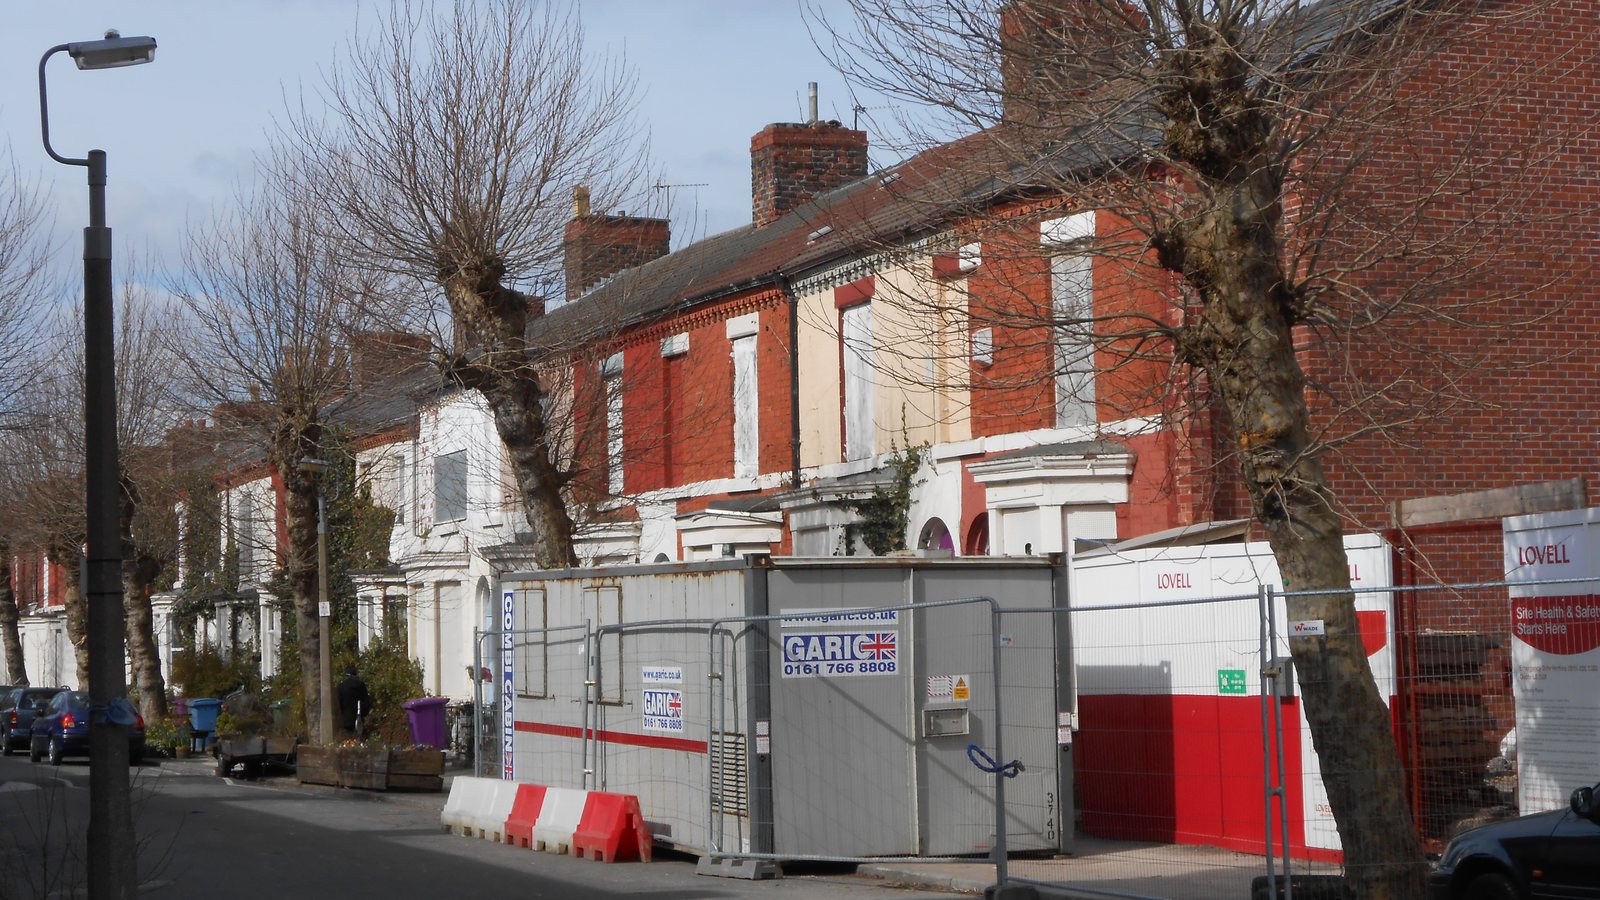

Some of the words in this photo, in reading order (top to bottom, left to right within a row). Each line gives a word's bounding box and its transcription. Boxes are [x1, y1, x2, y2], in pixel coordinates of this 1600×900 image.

[1518, 544, 1571, 566] LOVELL
[1157, 573, 1192, 589] LOVELL
[1516, 606, 1534, 620] Site
[1535, 605, 1565, 619] Health
[1566, 605, 1574, 618] &
[1575, 604, 1600, 618] Safet
[504, 595, 513, 673] COMBI
[1517, 622, 1543, 635] Starts
[1545, 622, 1568, 635] Here
[785, 635, 872, 661] GARIC
[784, 664, 820, 676] 0161
[826, 663, 854, 674] 766
[859, 661, 896, 673] 8808
[644, 692, 673, 717] GARIC
[504, 679, 513, 753] CABIN
[643, 717, 656, 728] 0161
[657, 718, 668, 729] 766
[669, 719, 682, 730] 8808
[1047, 792, 1055, 840] 3740
